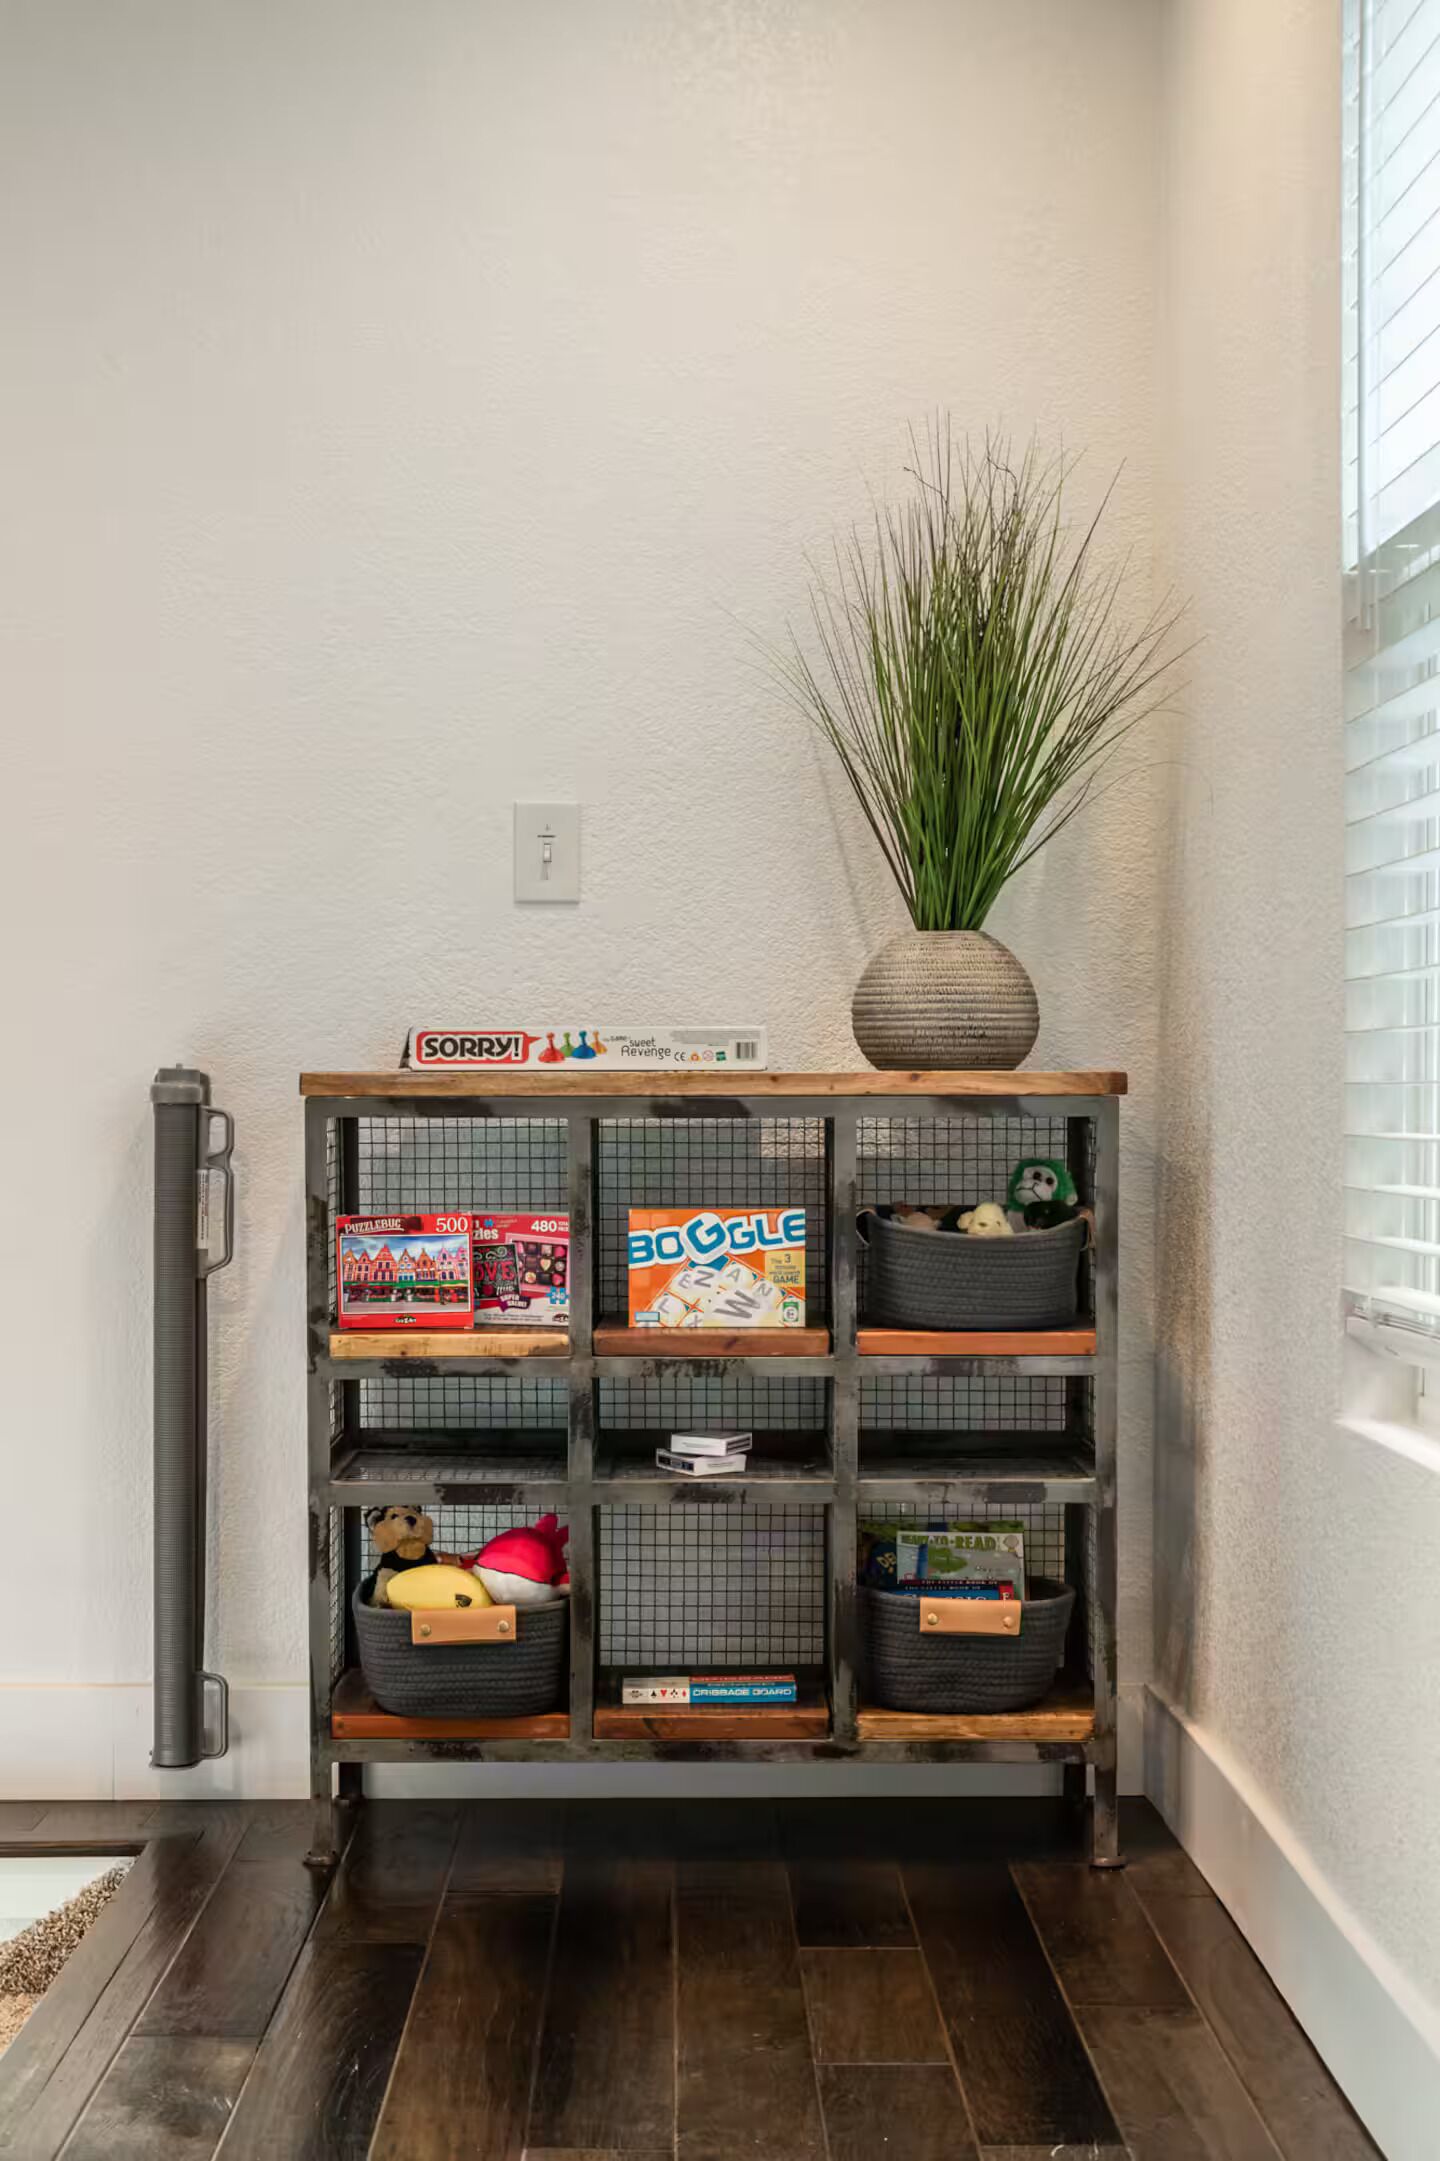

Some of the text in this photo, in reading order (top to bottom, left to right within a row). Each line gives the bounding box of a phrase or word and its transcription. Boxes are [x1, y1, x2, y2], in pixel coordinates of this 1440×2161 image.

[424, 1037, 520, 1058] SORRY!
[620, 1045, 671, 1060] Revenge
[435, 1217, 469, 1232] 500
[531, 1220, 558, 1232] 480
[473, 1228, 499, 1240] zles
[629, 1213, 806, 1265] BOGGLE
[472, 1260, 515, 1281] OVE
[773, 1275, 800, 1284] GAME
[692, 1688, 750, 1697] CRIBBAGE
